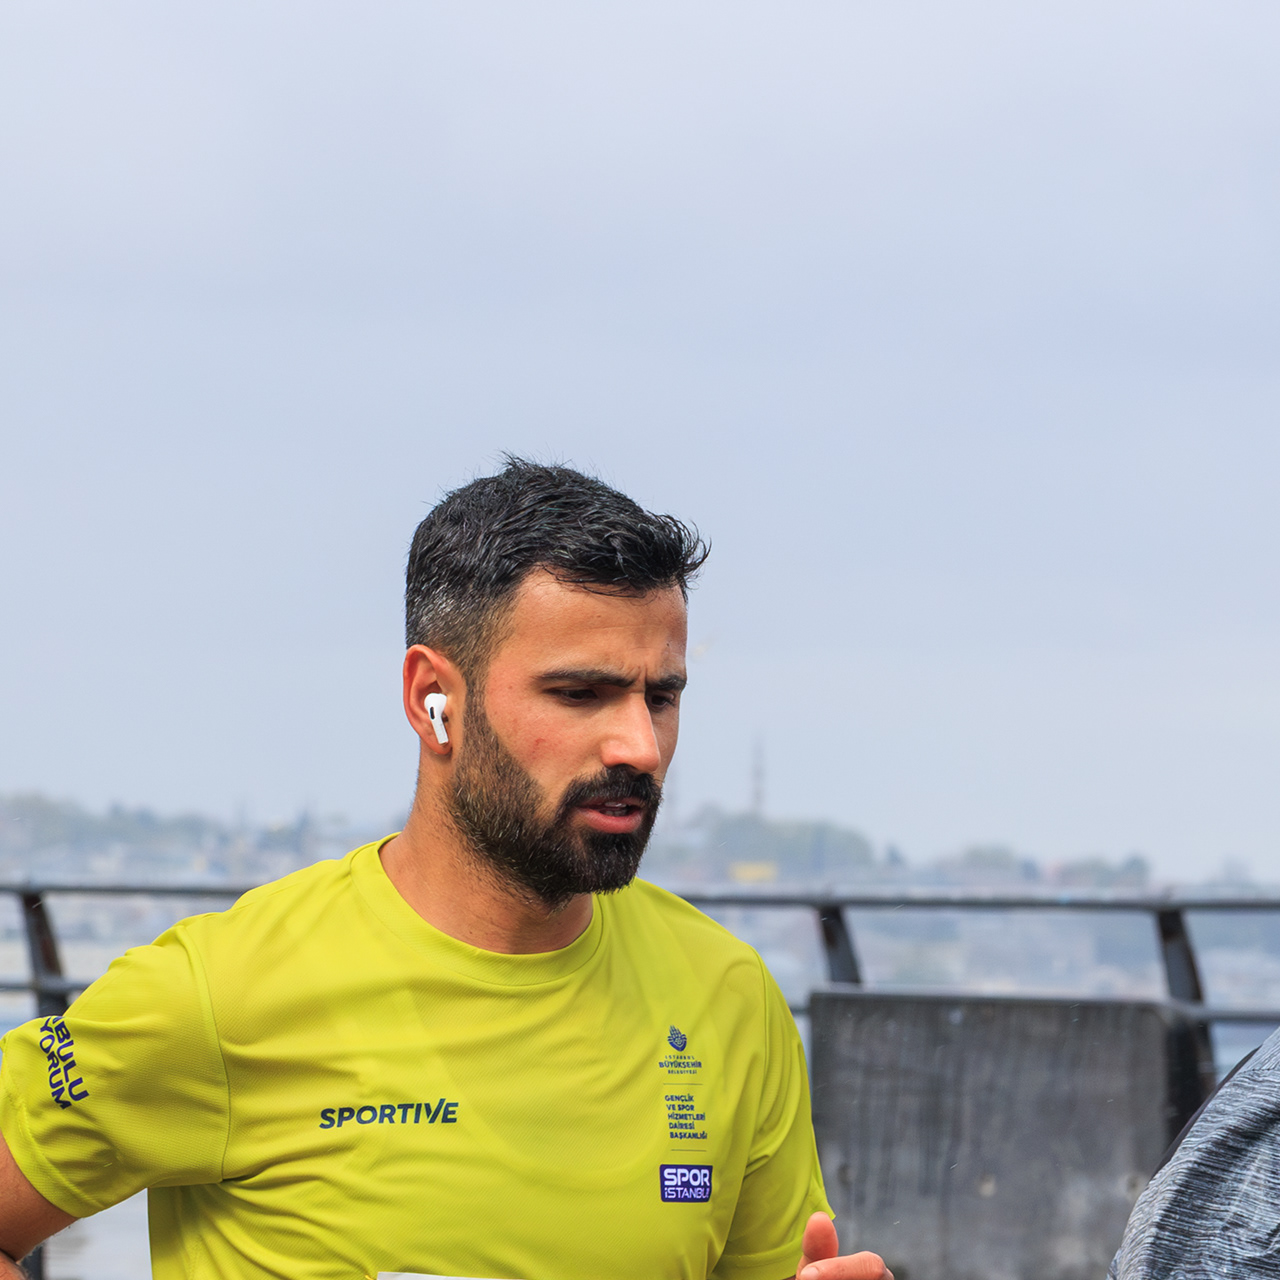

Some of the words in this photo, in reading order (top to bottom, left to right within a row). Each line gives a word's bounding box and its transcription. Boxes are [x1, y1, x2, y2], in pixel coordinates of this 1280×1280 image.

[52, 1016, 90, 1102] BULU
[318, 1098, 460, 1130] SPORTIVE
[663, 1168, 710, 1187] SPOR
